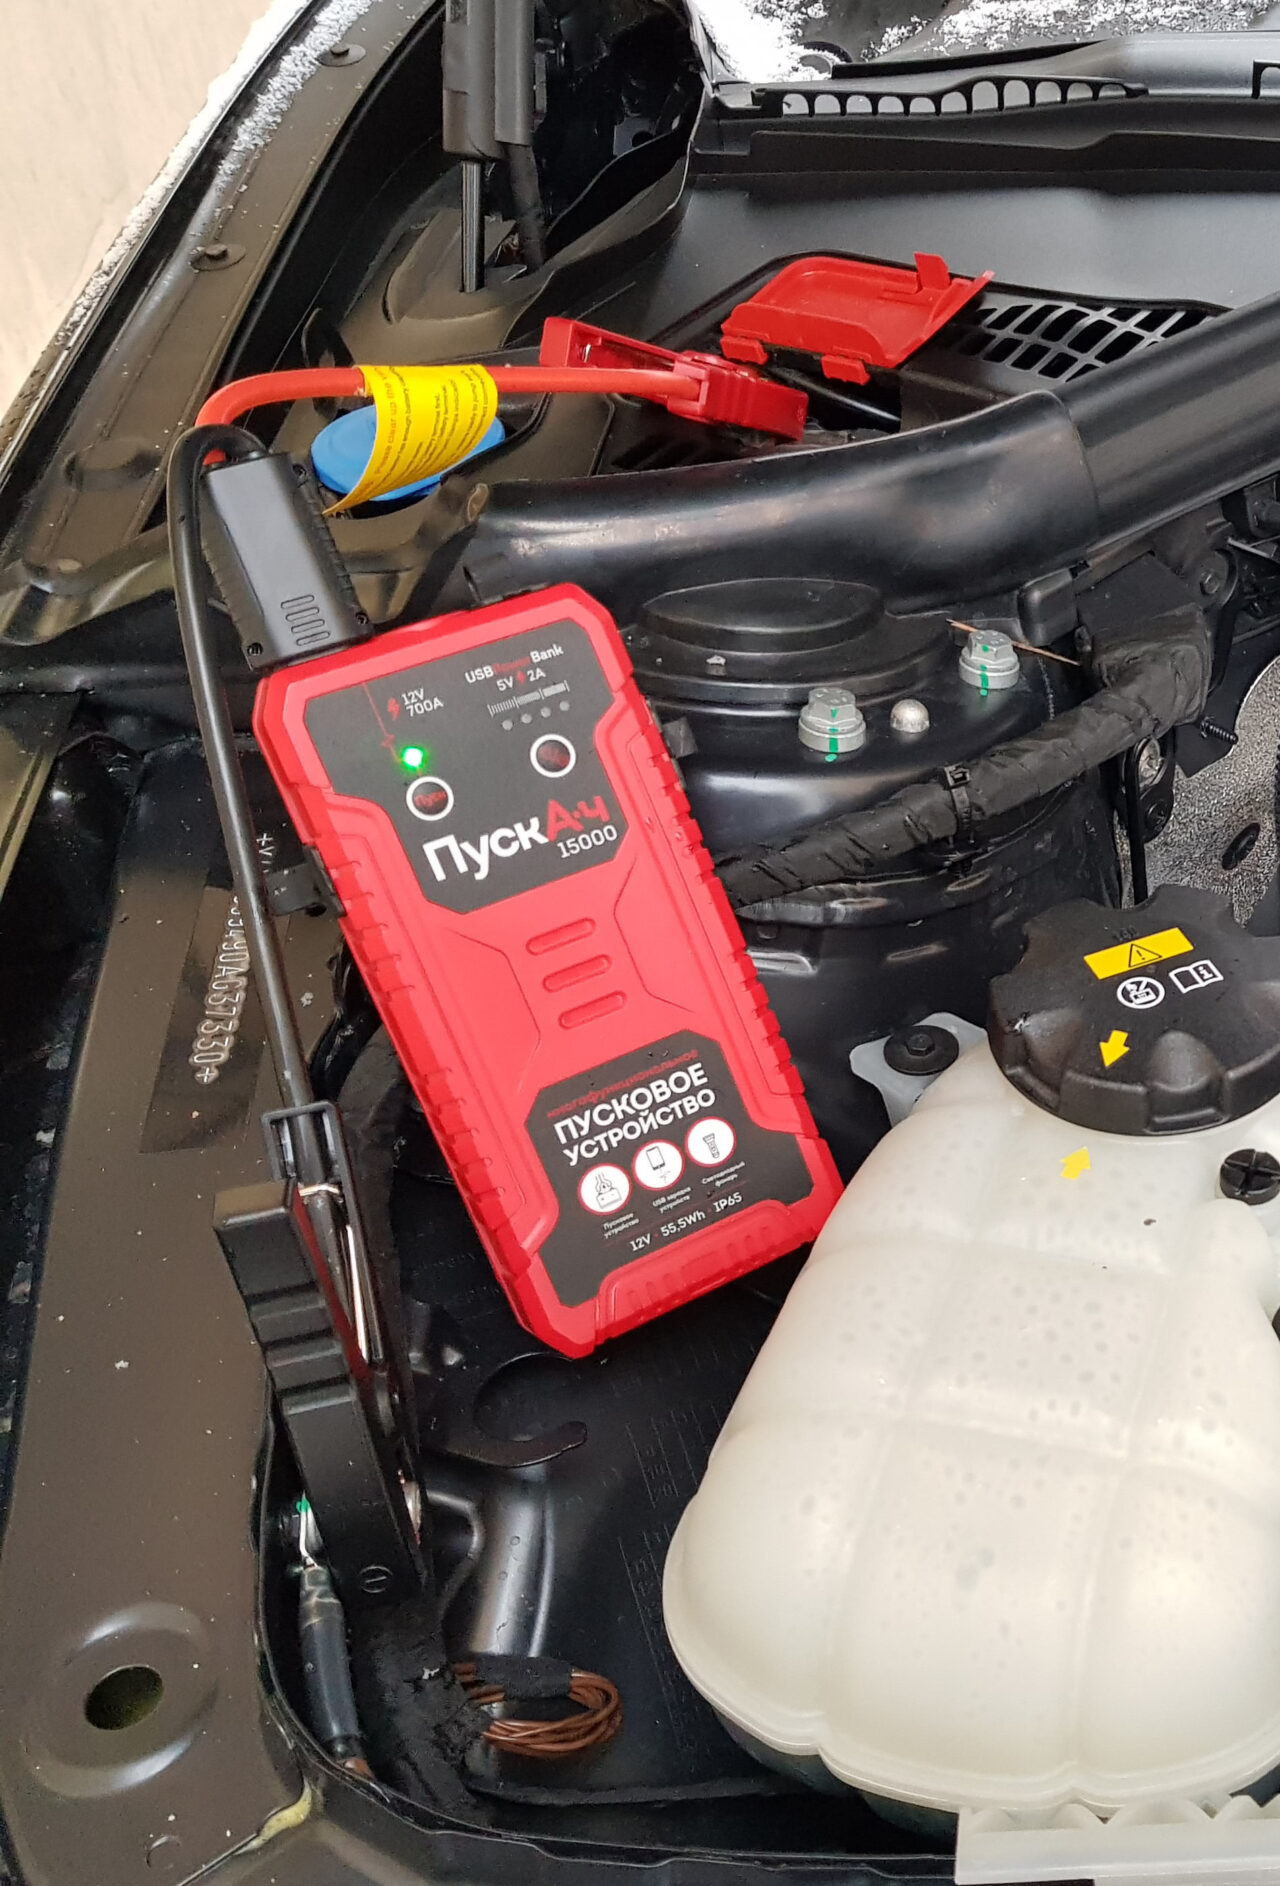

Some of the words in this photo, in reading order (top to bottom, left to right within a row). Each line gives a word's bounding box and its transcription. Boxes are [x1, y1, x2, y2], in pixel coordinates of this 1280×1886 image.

[464, 664, 494, 685] USB
[529, 643, 564, 664] Bank
[496, 675, 514, 692] 5V
[526, 667, 547, 682] 2A
[401, 687, 425, 706] 12V
[405, 697, 445, 718] 700A
[557, 824, 618, 859] 15000
[553, 1062, 709, 1145] ПУСКОВОЕ
[562, 1088, 717, 1167] УСТРОЙСТВО
[629, 1232, 652, 1252] 12V
[660, 1209, 706, 1237] 55,5Wh
[712, 1191, 743, 1213] IP65
